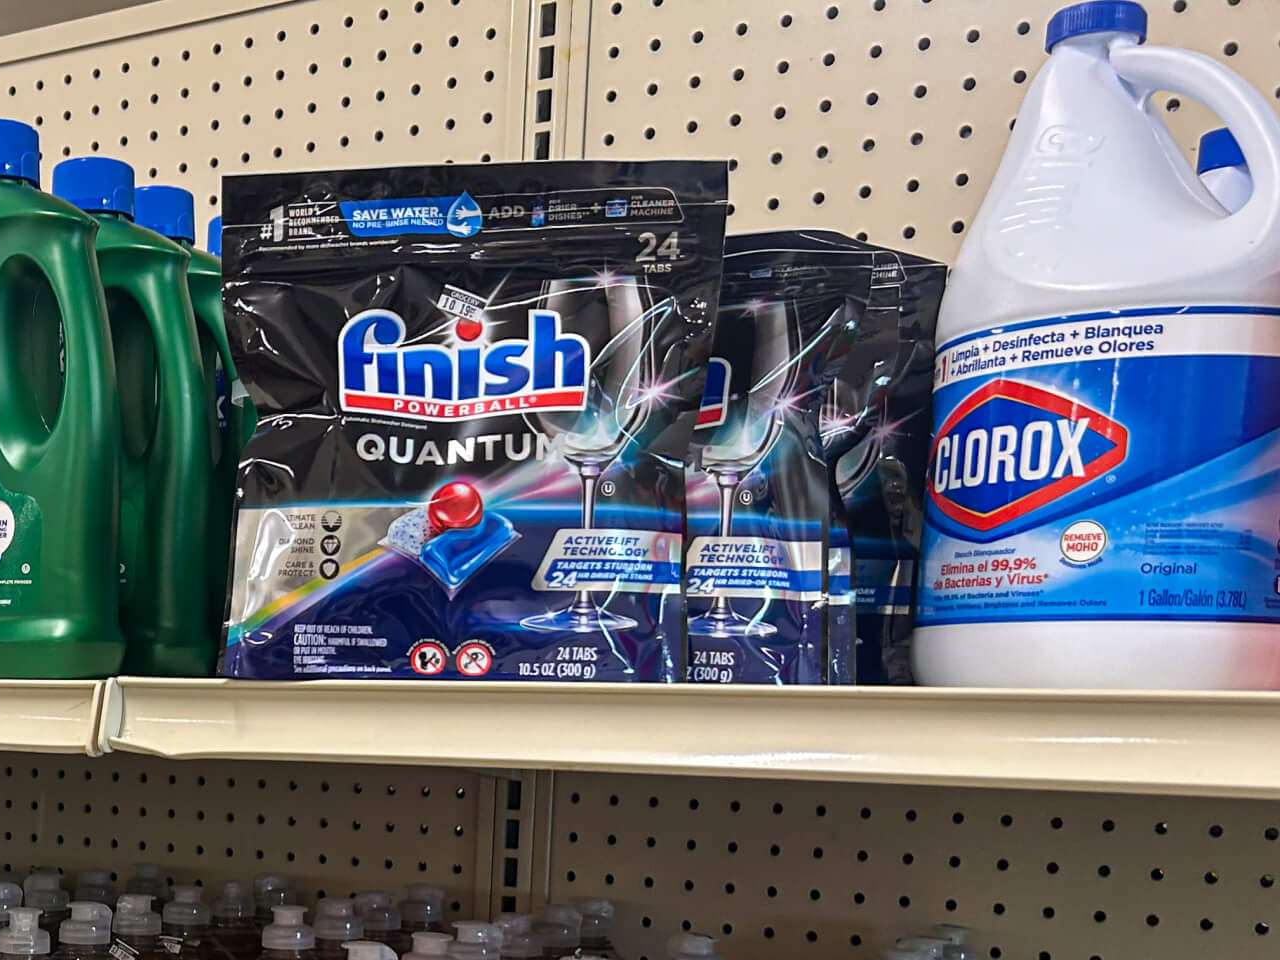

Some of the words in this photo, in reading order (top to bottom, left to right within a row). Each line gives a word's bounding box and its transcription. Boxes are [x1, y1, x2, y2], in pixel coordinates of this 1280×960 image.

[630, 200, 675, 208] CLEANER
[352, 208, 387, 221] SAVE
[488, 206, 525, 220] ADD
[630, 207, 674, 217] MACHINE
[288, 216, 340, 227] RECOMMENDED
[352, 221, 364, 229] NO
[366, 219, 411, 229] PRE-RINSE
[411, 217, 444, 227] NEEDED
[288, 227, 313, 235] BRAND
[635, 231, 681, 262] 24
[642, 264, 673, 274] TABS
[951, 346, 980, 363] Limpia
[992, 331, 1066, 352] Desinfecta
[1084, 324, 1165, 343] Blanquea
[342, 313, 586, 401] finish
[956, 354, 1006, 375] Abrillanta
[1021, 342, 1094, 362] Remueve
[1098, 339, 1156, 353] Olores
[393, 396, 530, 417] POWERBALL
[356, 433, 567, 466] QUANTUM
[933, 417, 1091, 494] CLOROX
[1063, 532, 1103, 542] REMUEVE
[291, 546, 315, 554] SHINE
[561, 546, 649, 557] TECHNOLOGY
[700, 543, 777, 555] ACTIVELIFT
[1066, 542, 1099, 552] MOHO
[285, 561, 308, 569] CARE
[556, 561, 602, 570] TARGETS
[699, 554, 785, 565] TECHNOLOGY
[941, 563, 975, 576] Elimina
[977, 561, 988, 572] el
[991, 557, 1037, 573] 99,9%
[692, 568, 736, 577] TARGETS
[1140, 562, 1197, 576] Original
[547, 571, 577, 588] 24
[576, 572, 587, 580] HR
[687, 577, 714, 594] 24
[944, 575, 992, 590] Bacterias
[995, 576, 1003, 588] y
[1139, 589, 1145, 607] 1
[1148, 588, 1214, 608] Gallon/Galón
[556, 647, 570, 661] 24
[571, 647, 598, 661] TABS
[694, 651, 708, 665] 24
[709, 652, 734, 665] TABS
[519, 663, 540, 676] 10.5
[541, 663, 555, 676] OZ
[556, 663, 581, 678] (300
[582, 664, 596, 678] g)
[694, 667, 719, 682] (300
[720, 668, 733, 682] g)
